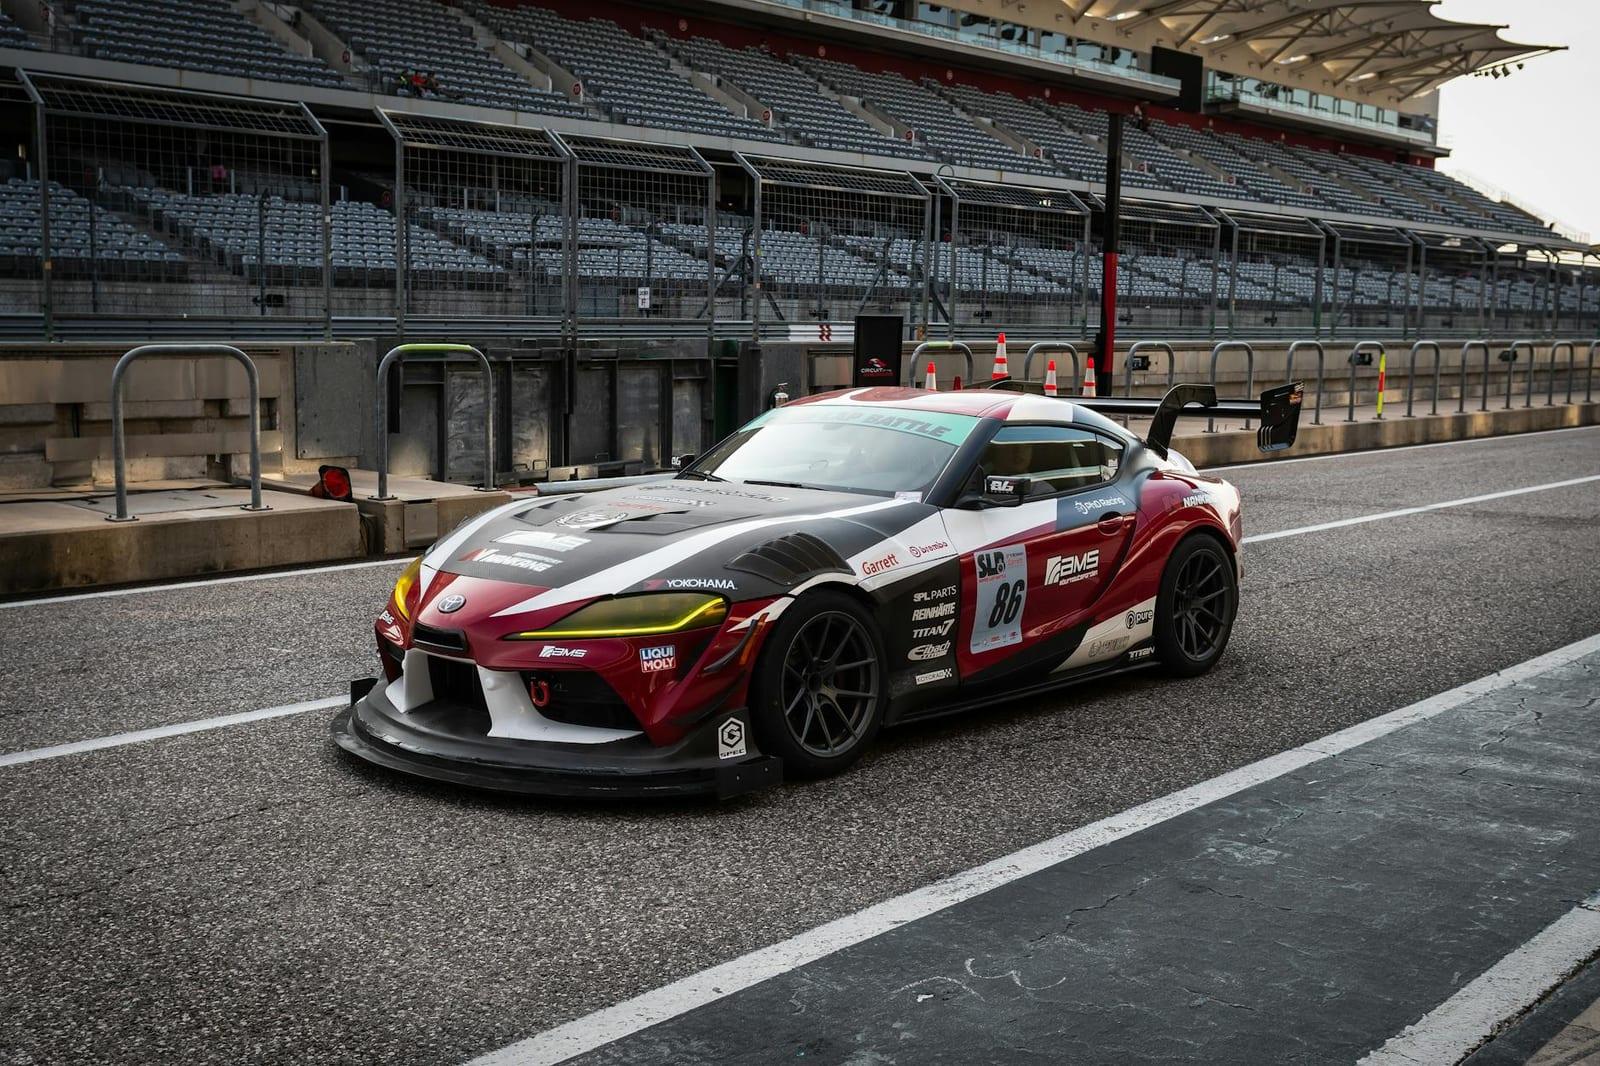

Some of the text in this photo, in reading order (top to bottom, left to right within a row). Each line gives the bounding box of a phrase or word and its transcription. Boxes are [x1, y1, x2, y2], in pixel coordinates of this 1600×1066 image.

[862, 413, 953, 438] BATTLE
[1102, 496, 1125, 508] Racing
[921, 541, 948, 554] brembo
[862, 553, 900, 575] Garrett
[666, 578, 736, 590] YOKOHAMA
[912, 585, 957, 602] SPL PARTS
[988, 579, 1025, 629] 86
[1136, 609, 1154, 625] pure
[641, 646, 674, 660] LIQUI
[643, 657, 675, 671] MOLY
